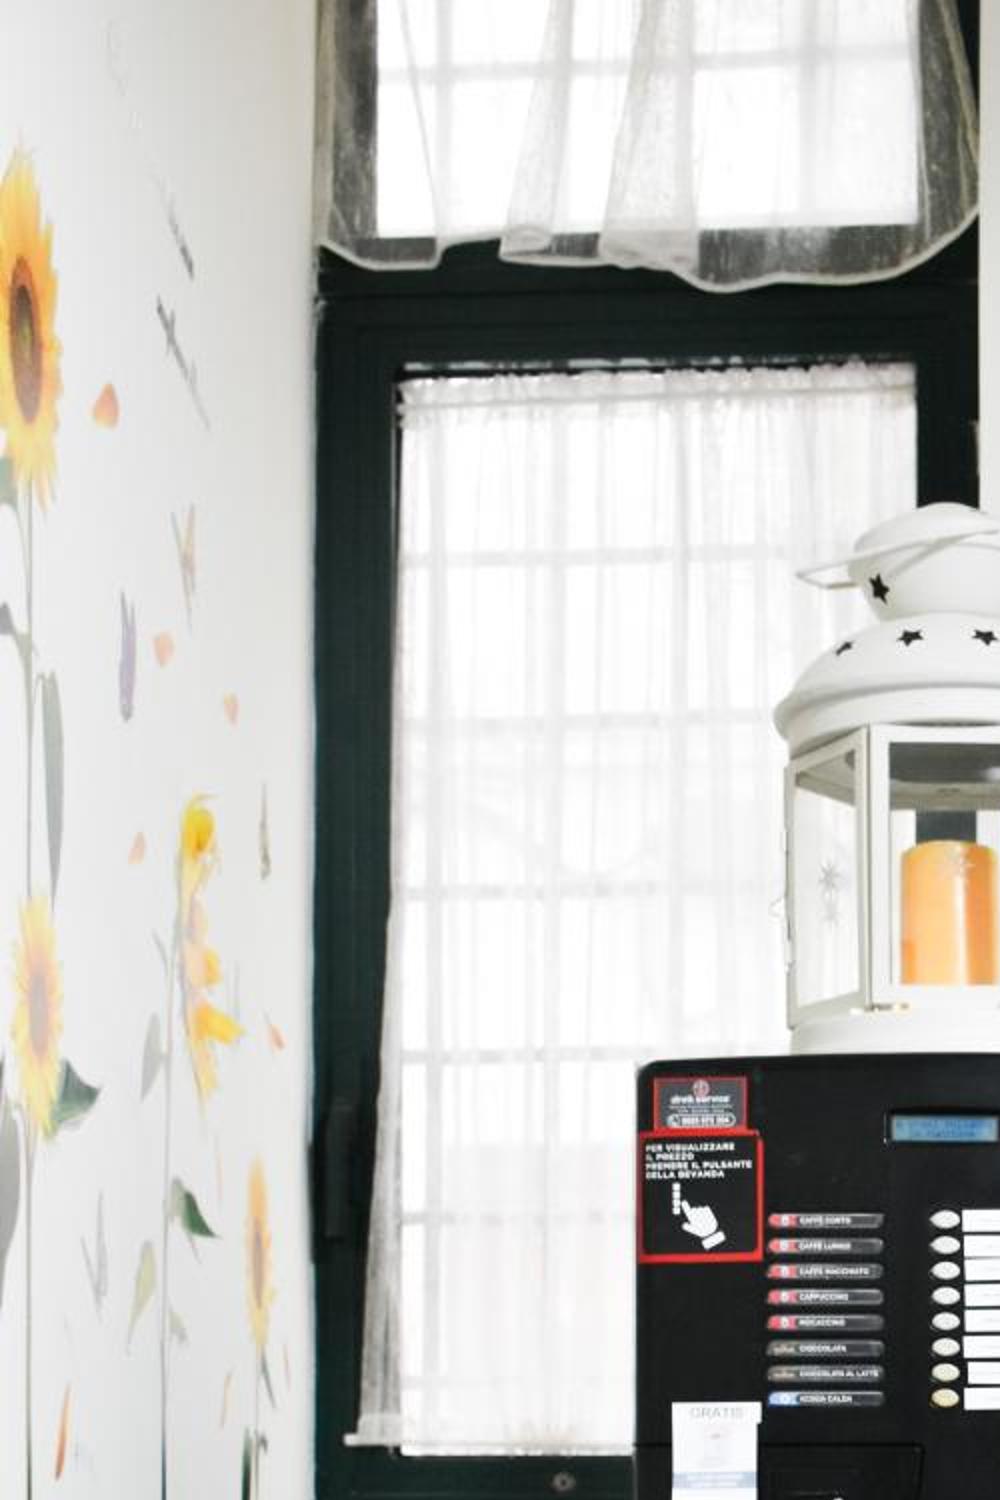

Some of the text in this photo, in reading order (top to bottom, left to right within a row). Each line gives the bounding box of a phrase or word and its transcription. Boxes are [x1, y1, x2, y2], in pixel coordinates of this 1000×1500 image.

[646, 1142, 735, 1152] PER VISUALIZZARE
[655, 1152, 694, 1160] PREZZO
[646, 1161, 688, 1170] PREMERE
[703, 1160, 753, 1169] PULSANTE
[646, 1169, 724, 1179] DELLA BEVANDA
[800, 1292, 848, 1301] CAPPUCCINO
[800, 1344, 847, 1353] CIOCCOLATA
[828, 1395, 852, 1403] CALDA
[690, 1406, 745, 1419] GRATIS
